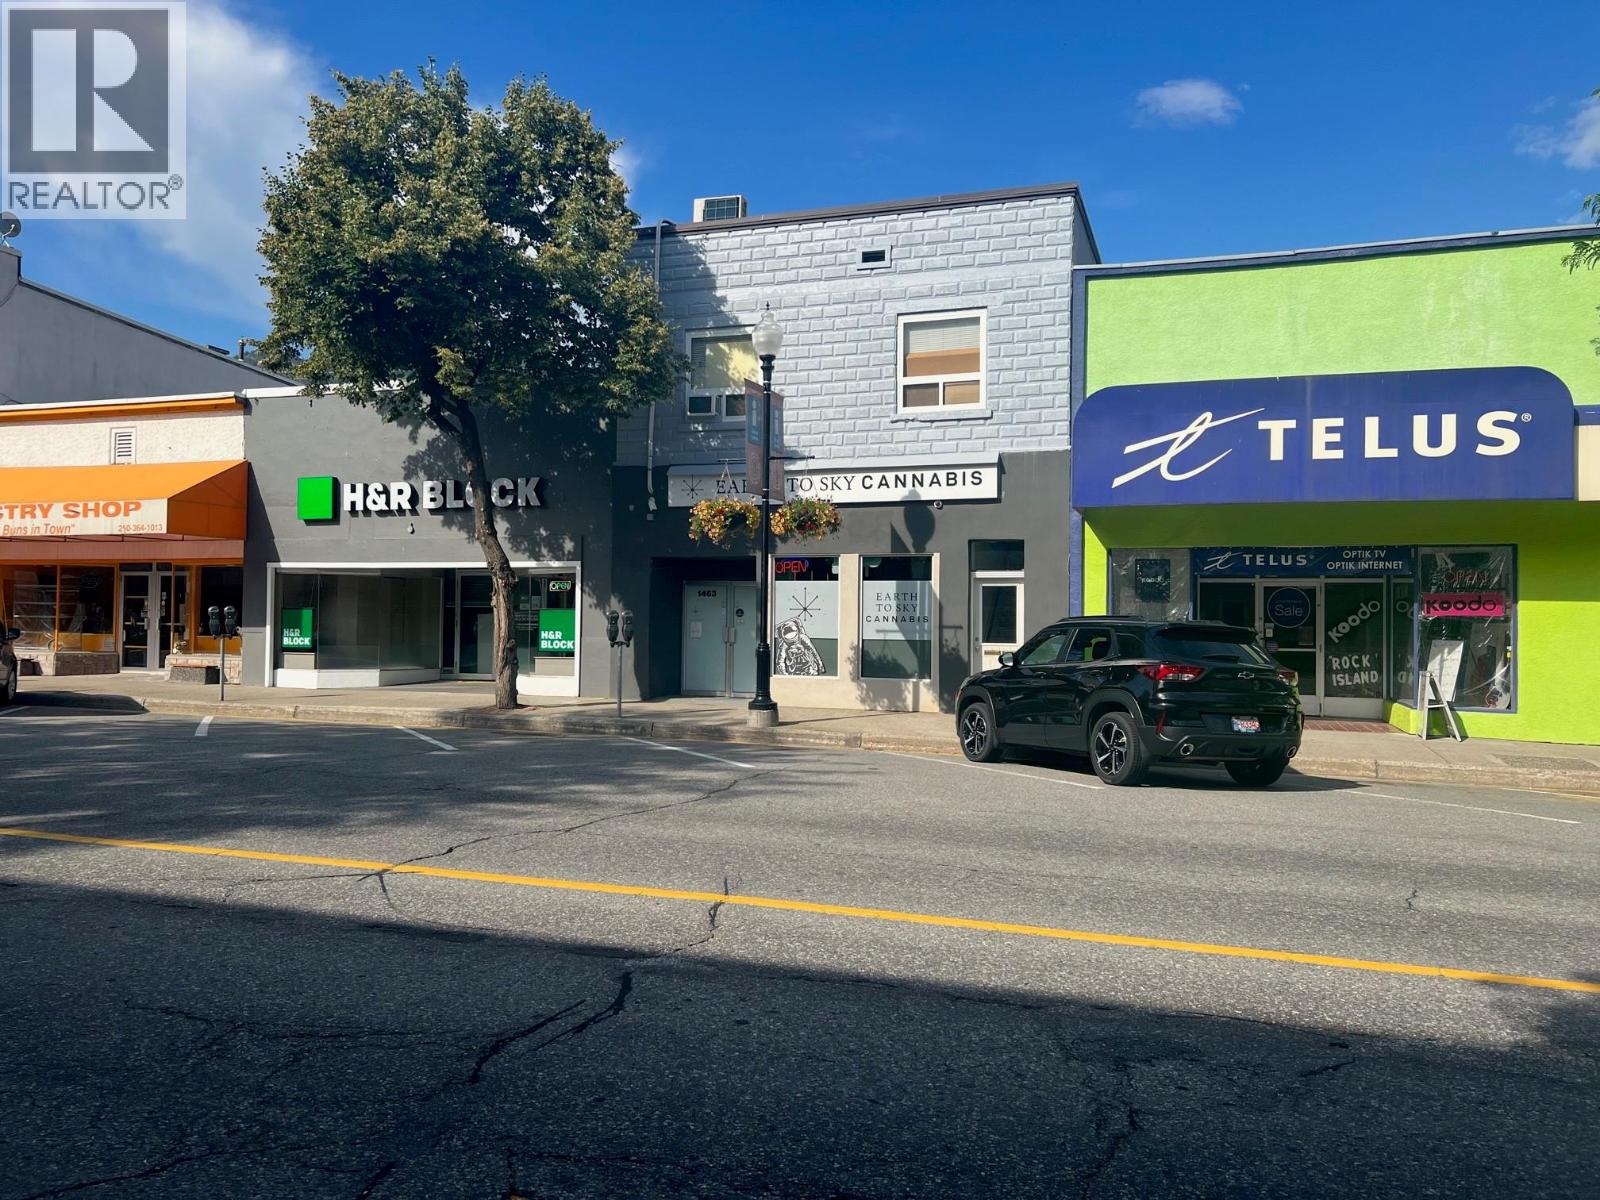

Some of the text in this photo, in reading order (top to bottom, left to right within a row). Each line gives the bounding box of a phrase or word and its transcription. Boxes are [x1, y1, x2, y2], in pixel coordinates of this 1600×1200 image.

[786, 477, 813, 493] TO
[820, 475, 855, 491] SKY
[862, 470, 983, 490] CANNABIS
[343, 482, 412, 511] H&R
[0, 501, 142, 520] TRY SHOP
[3, 524, 28, 536] Buns
[31, 523, 41, 535] in
[1343, 550, 1387, 559] OPTIK TV
[775, 560, 807, 574] OPEN
[1327, 560, 1403, 570] OPTIK INTERNET
[876, 592, 918, 601] EARTH
[876, 603, 918, 612] TO SKY
[1274, 604, 1304, 617] Sale
[865, 615, 930, 624] CANNABIS
[283, 628, 301, 637] H&R
[541, 630, 562, 640] H&R
[283, 637, 311, 646] BLOCK
[541, 640, 574, 649] BLOCK
[1332, 670, 1379, 687] ISLAND
